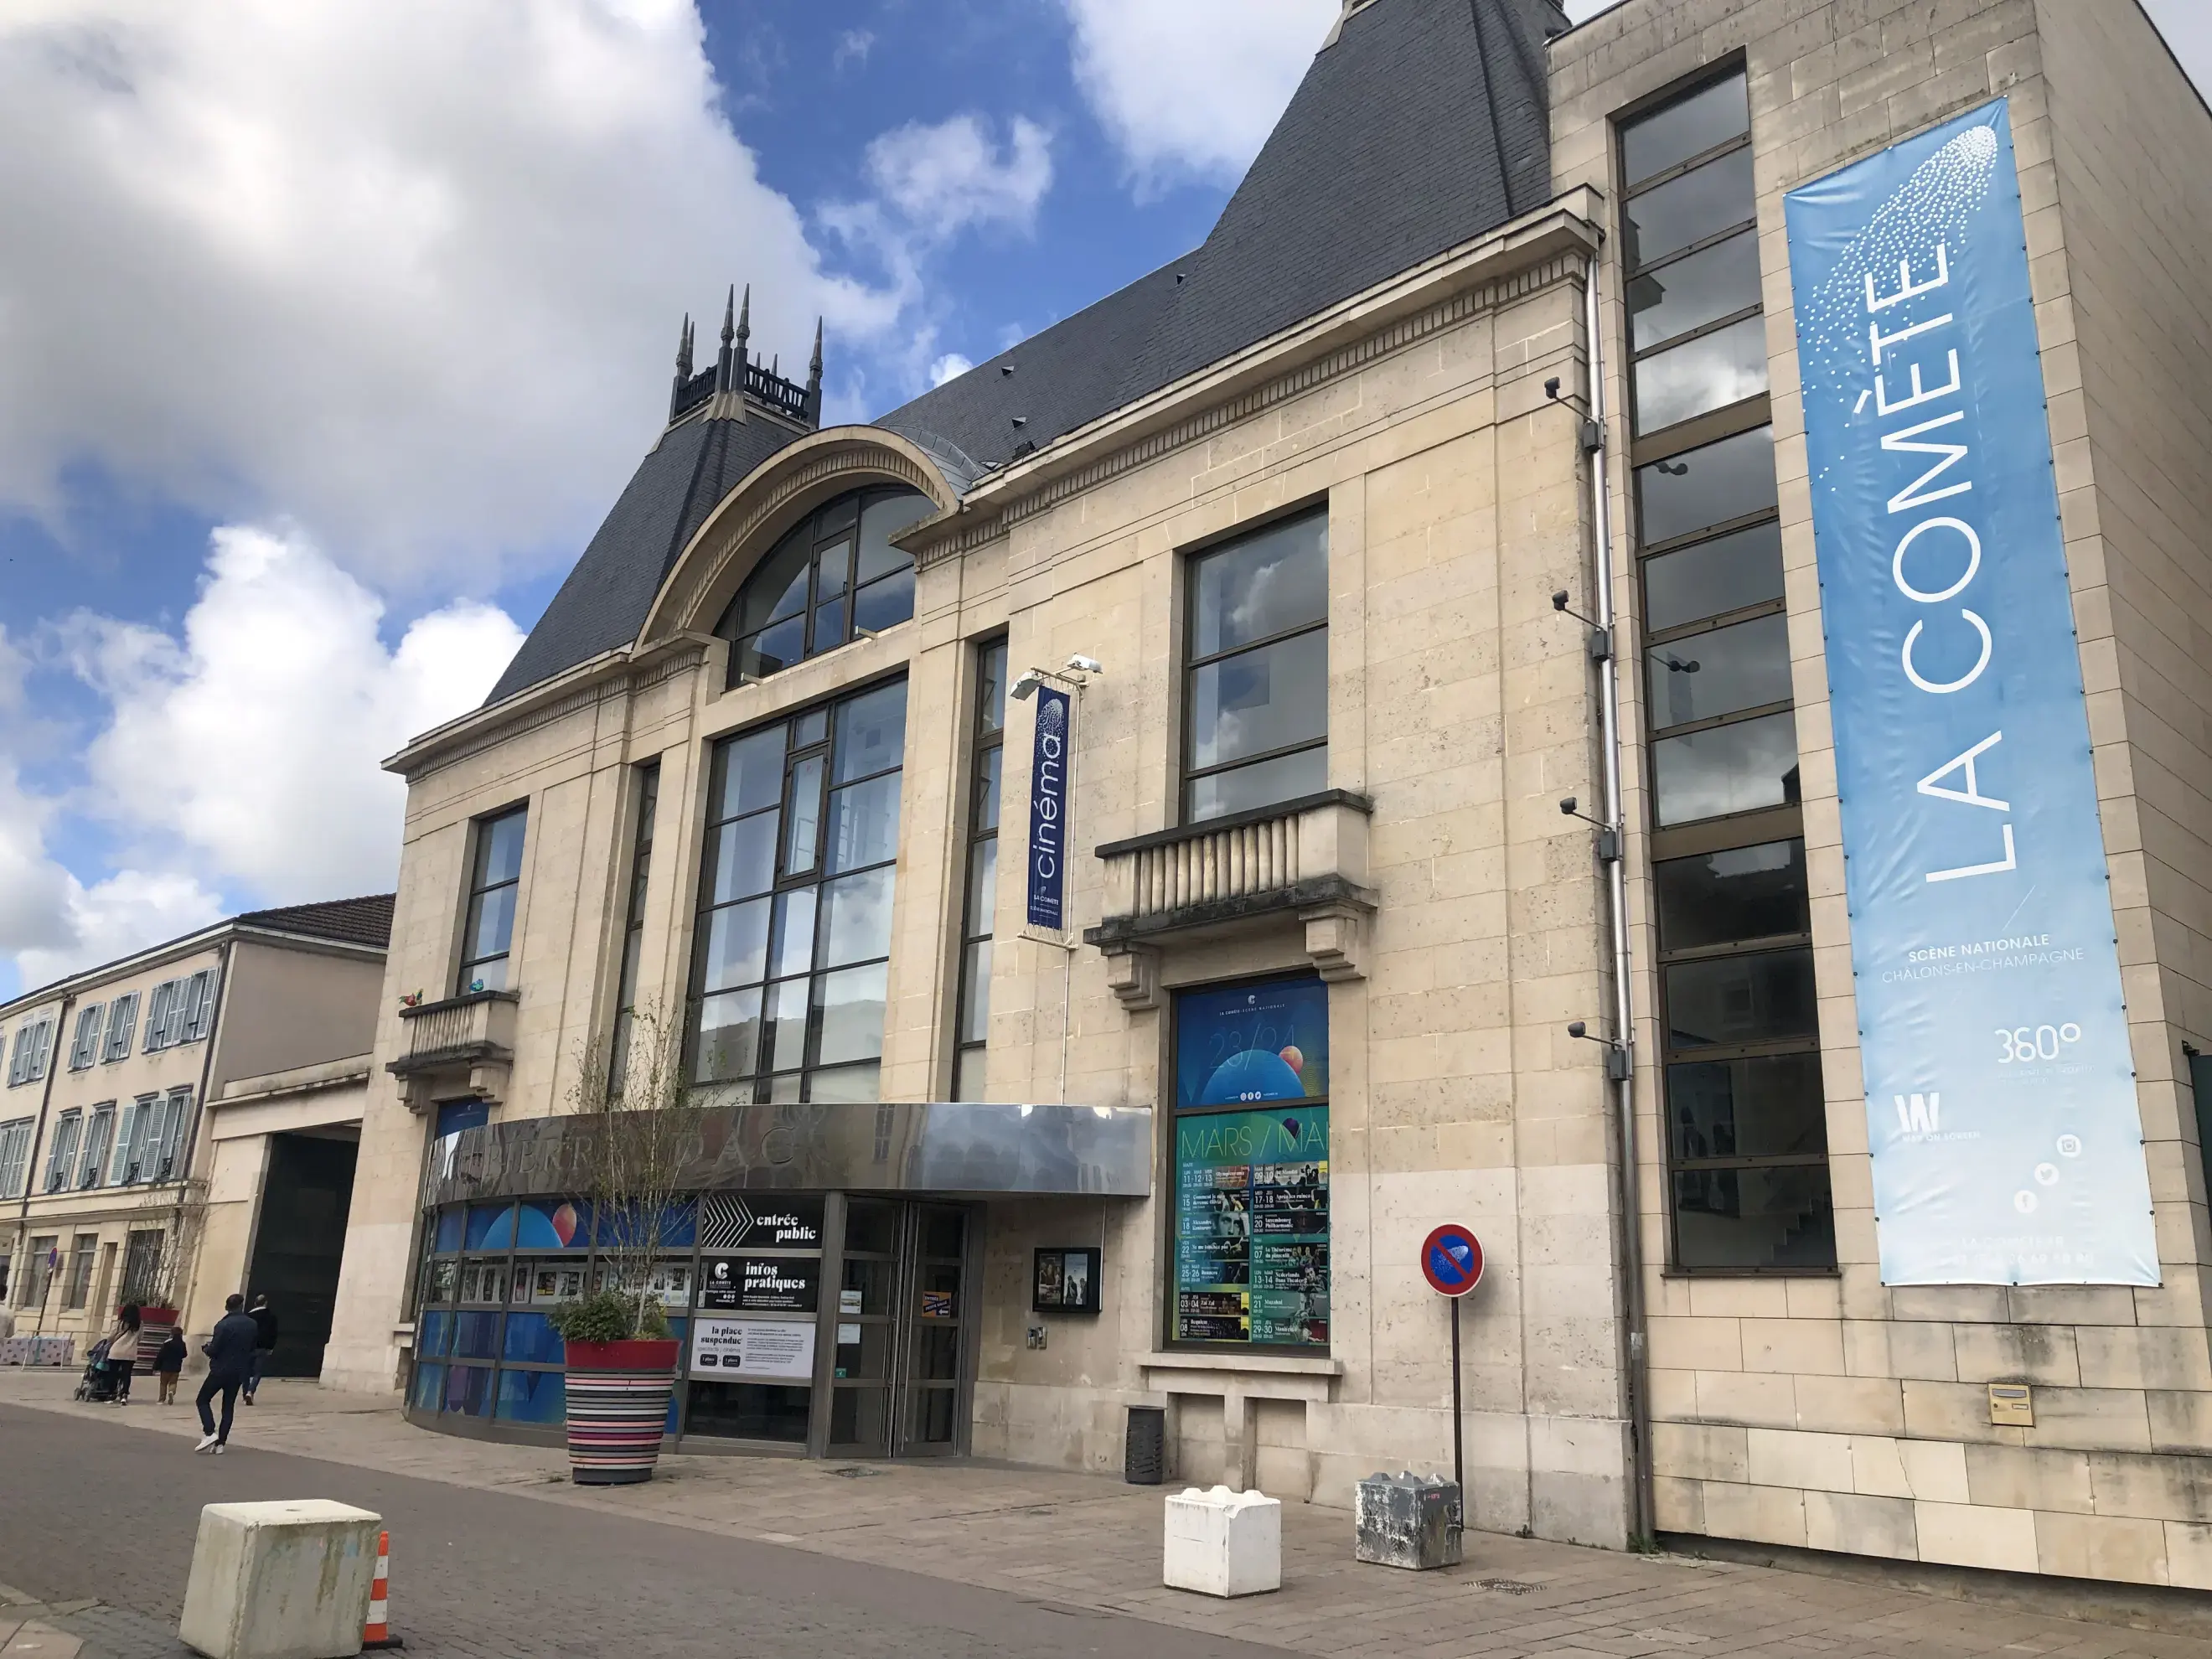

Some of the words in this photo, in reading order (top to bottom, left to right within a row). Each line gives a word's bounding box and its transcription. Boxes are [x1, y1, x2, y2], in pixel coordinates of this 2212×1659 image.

[1853, 243, 1992, 694] COMÈTE
[1032, 735, 1061, 879] cinéma
[1917, 731, 2016, 881] LA
[1909, 946, 1956, 963] SCÈNE
[1961, 934, 2050, 956] NATIONALE
[1882, 948, 2085, 984] CHÂLONS-EN-CHAMPAGNE
[1182, 1126, 1253, 1159] MARS
[757, 1213, 798, 1226] entrée
[1254, 1220, 1263, 1228] 20
[775, 1227, 816, 1243] public
[745, 1261, 778, 1275] infos
[744, 1274, 806, 1292] pratiques
[1254, 1275, 1262, 1284] 13
[1264, 1275, 1273, 1284] 14
[1191, 1300, 1199, 1308] 04
[711, 1326, 719, 1335] la
[721, 1327, 742, 1336] place
[700, 1336, 742, 1346] suspendue
